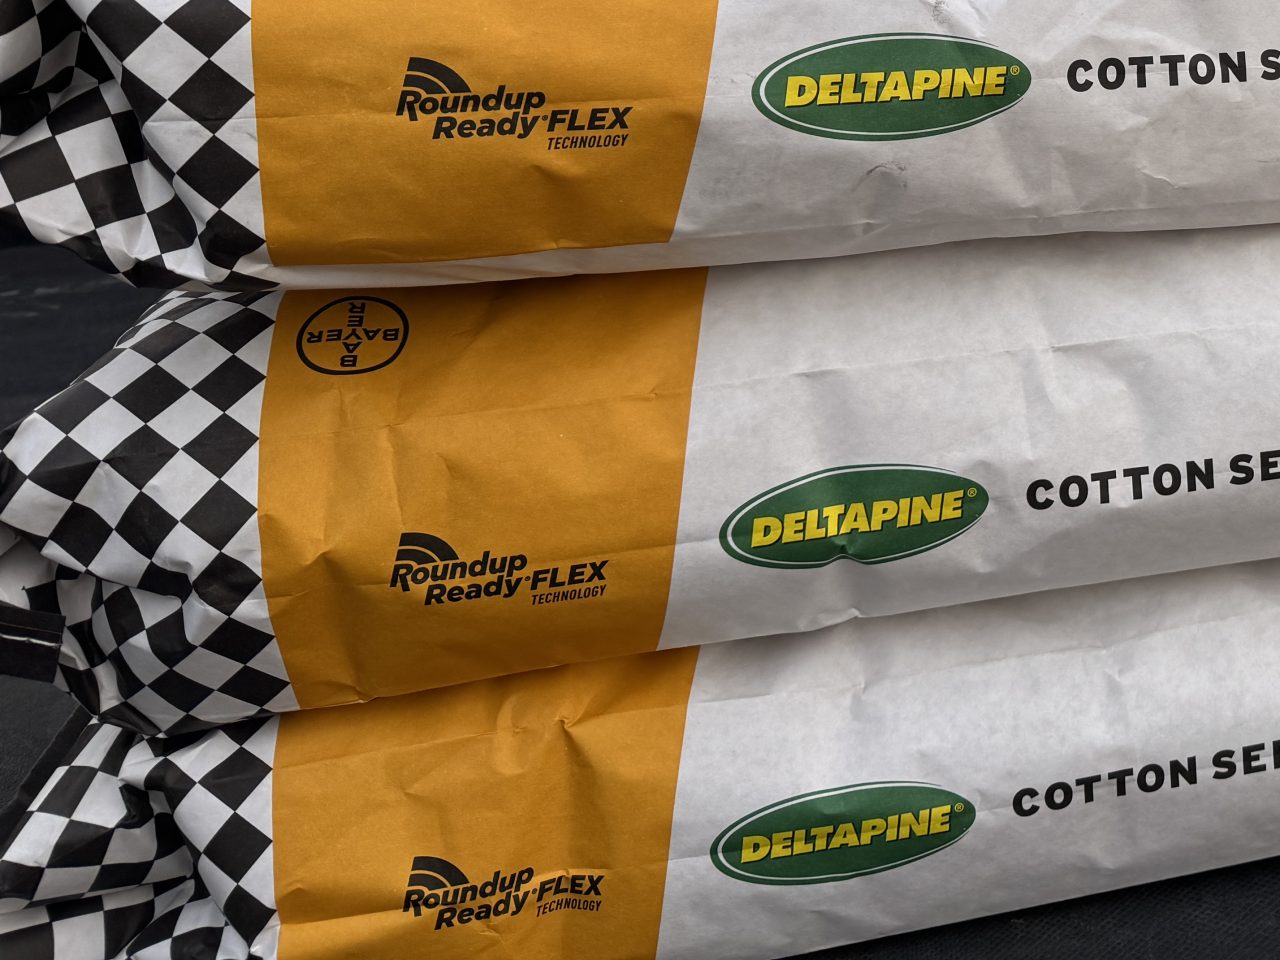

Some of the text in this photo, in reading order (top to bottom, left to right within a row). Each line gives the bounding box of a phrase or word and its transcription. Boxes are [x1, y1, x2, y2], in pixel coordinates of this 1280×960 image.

[1066, 50, 1248, 93] COTTON
[395, 85, 546, 122] Roundup
[547, 106, 634, 133] FLEX
[547, 133, 629, 151] TECHNOLOGY
[306, 327, 400, 344] BAYER
[340, 302, 366, 368] BAYER
[1026, 457, 1215, 511] COTTON
[389, 550, 528, 593] Roundup
[530, 559, 610, 591] FLEX
[531, 584, 607, 606] TECHNOLOGY
[1012, 755, 1198, 818] COTTON
[402, 867, 535, 918] Roundup
[536, 874, 605, 903] FLEX
[536, 897, 603, 918] TECHNOLOGY
